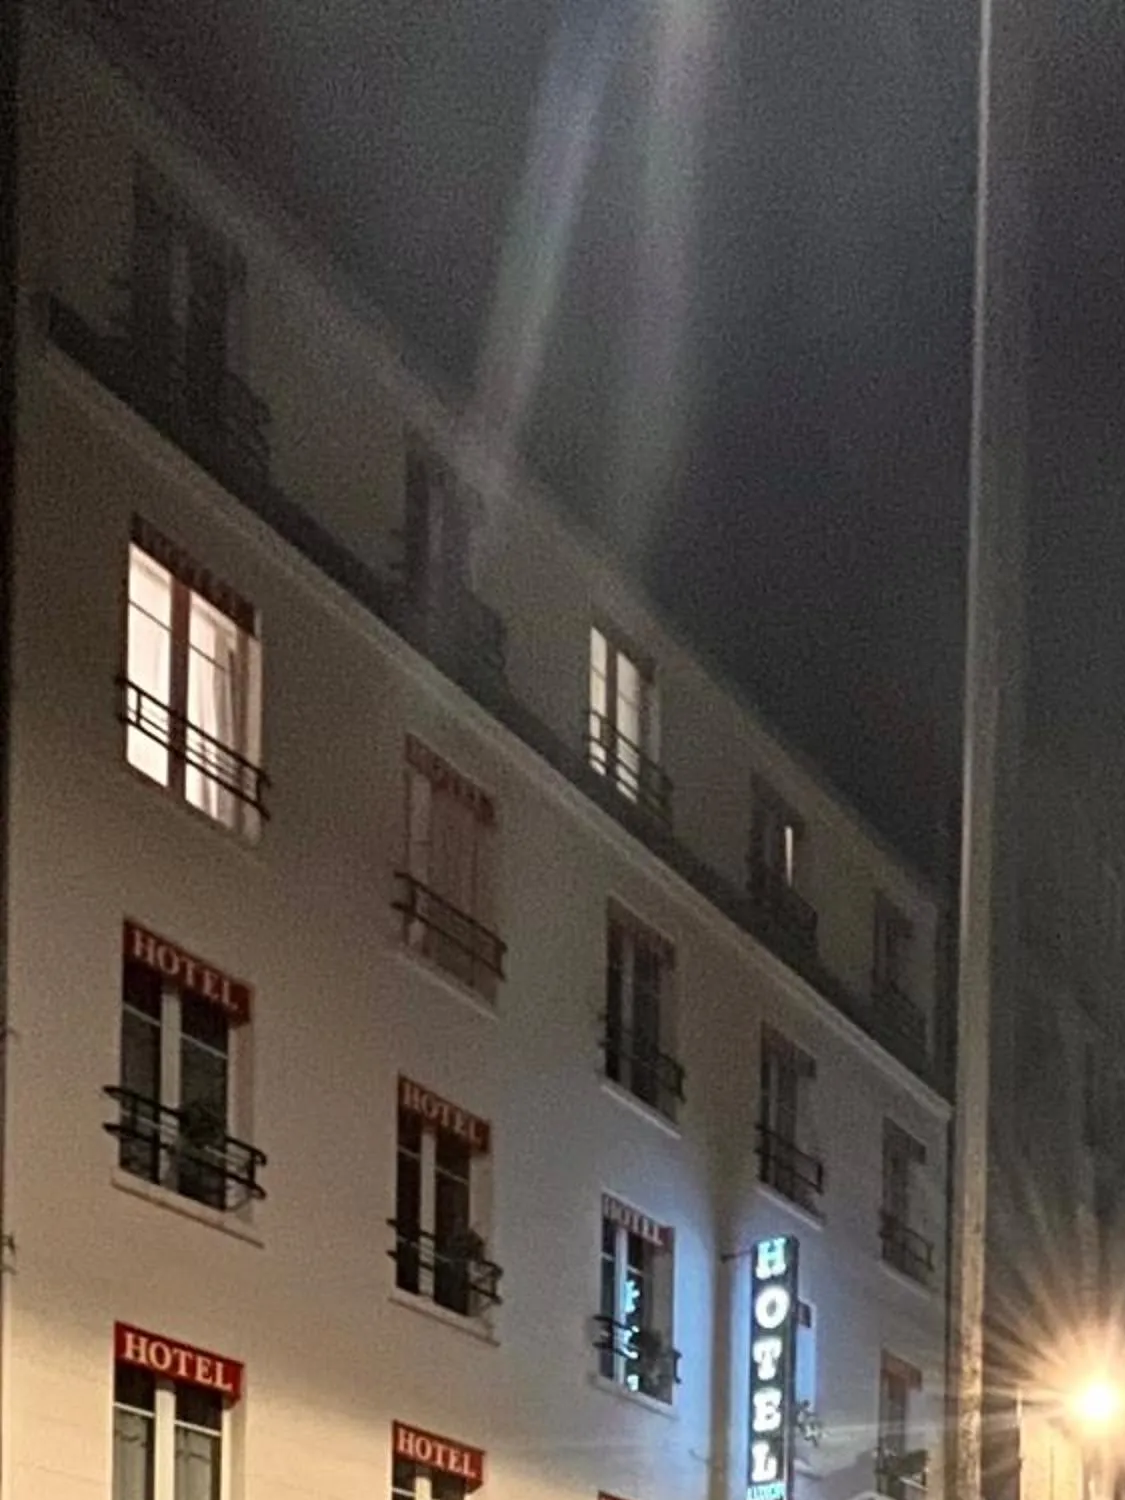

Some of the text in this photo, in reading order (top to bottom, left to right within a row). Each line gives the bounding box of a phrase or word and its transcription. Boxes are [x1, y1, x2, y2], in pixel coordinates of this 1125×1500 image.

[133, 929, 239, 1011] HOTEL
[403, 1083, 481, 1144] HOTEL
[124, 1332, 233, 1391] HOTEL
[752, 1238, 790, 1482] HOTEL
[397, 1428, 476, 1478] HOTEL
